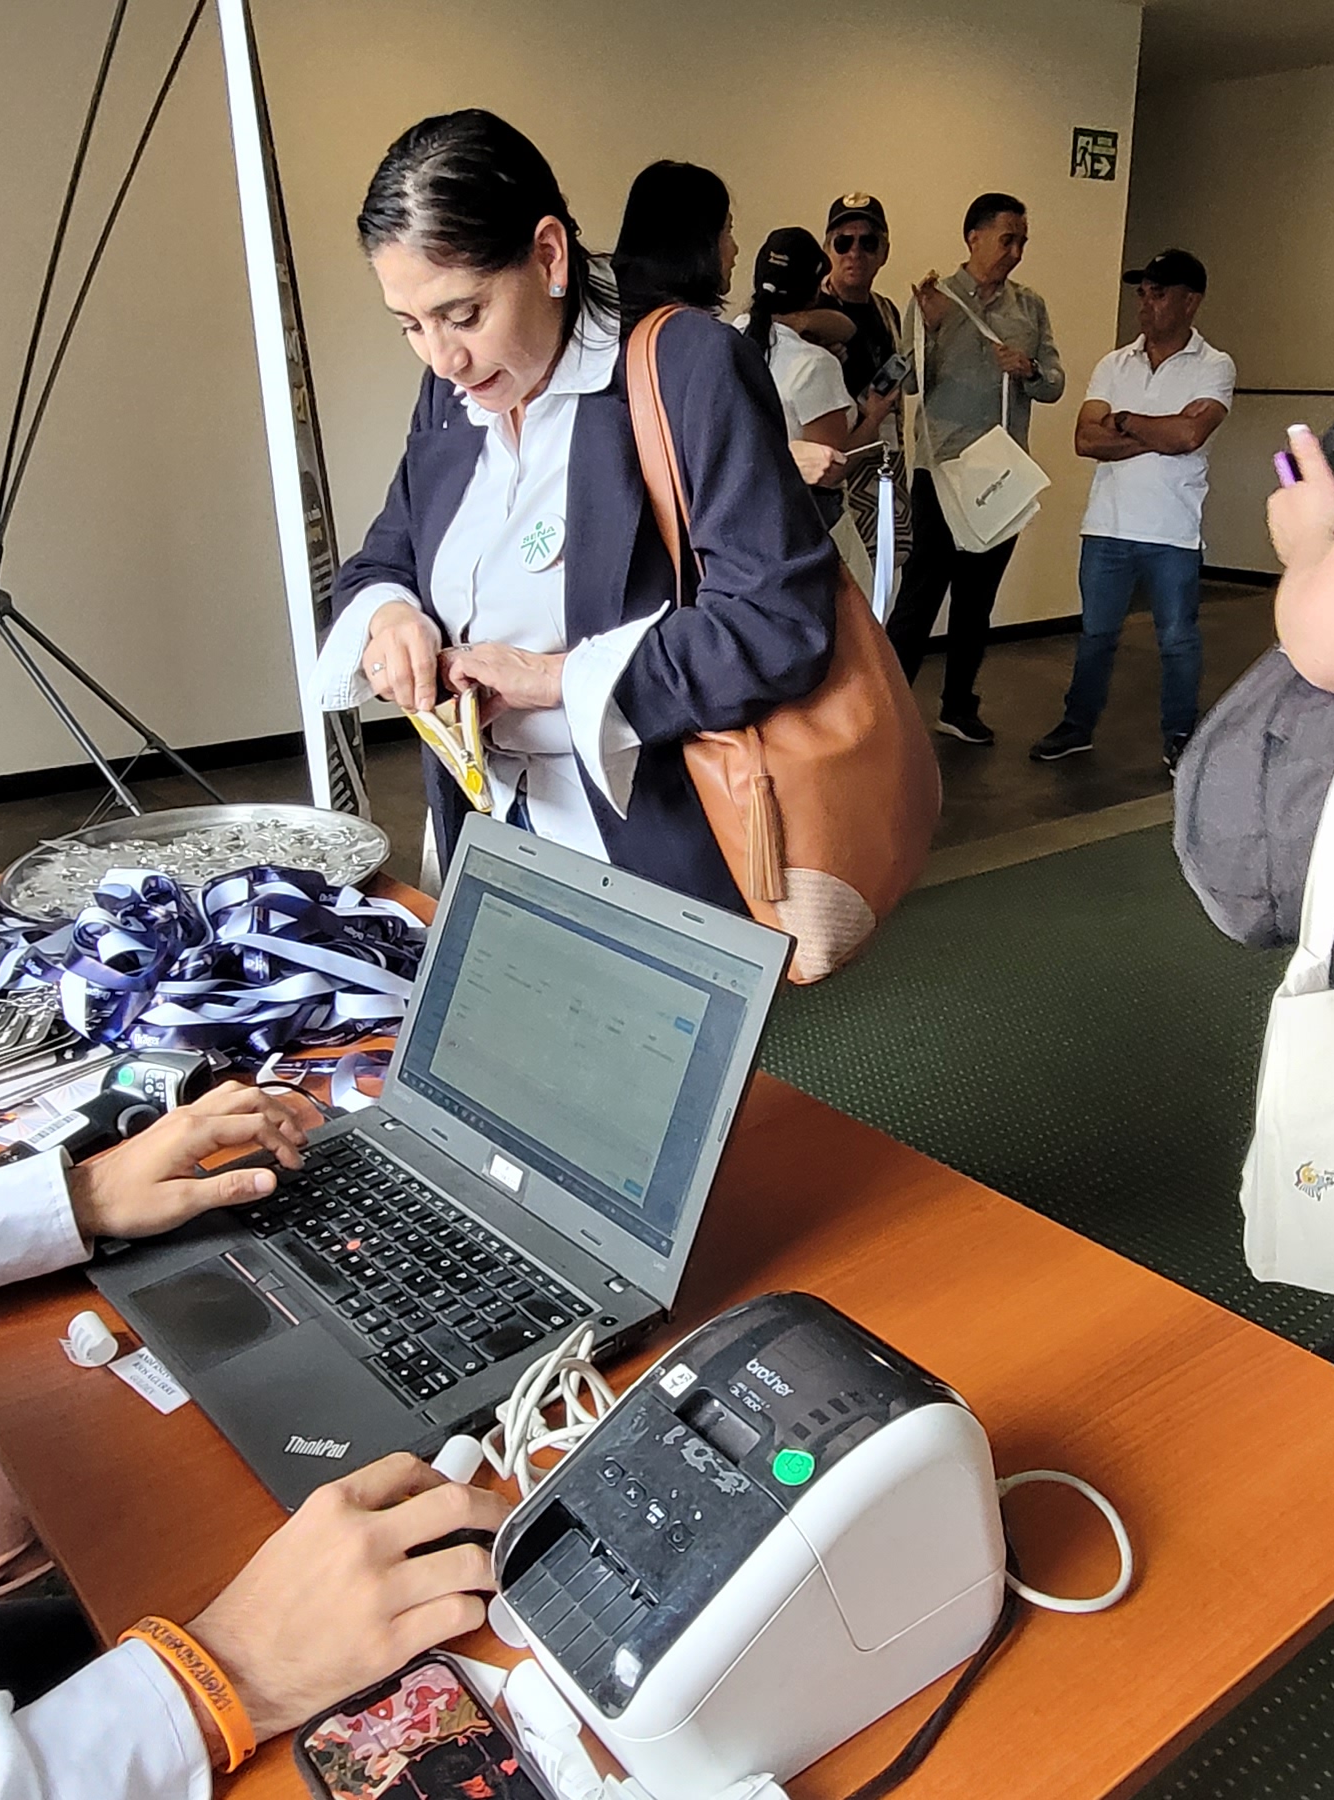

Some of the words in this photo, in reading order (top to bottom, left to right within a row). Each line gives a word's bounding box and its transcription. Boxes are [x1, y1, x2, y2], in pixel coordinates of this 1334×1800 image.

[523, 526, 555, 543] SENA
[745, 1357, 795, 1397] brother
[283, 1434, 351, 1459] ThinkPad
